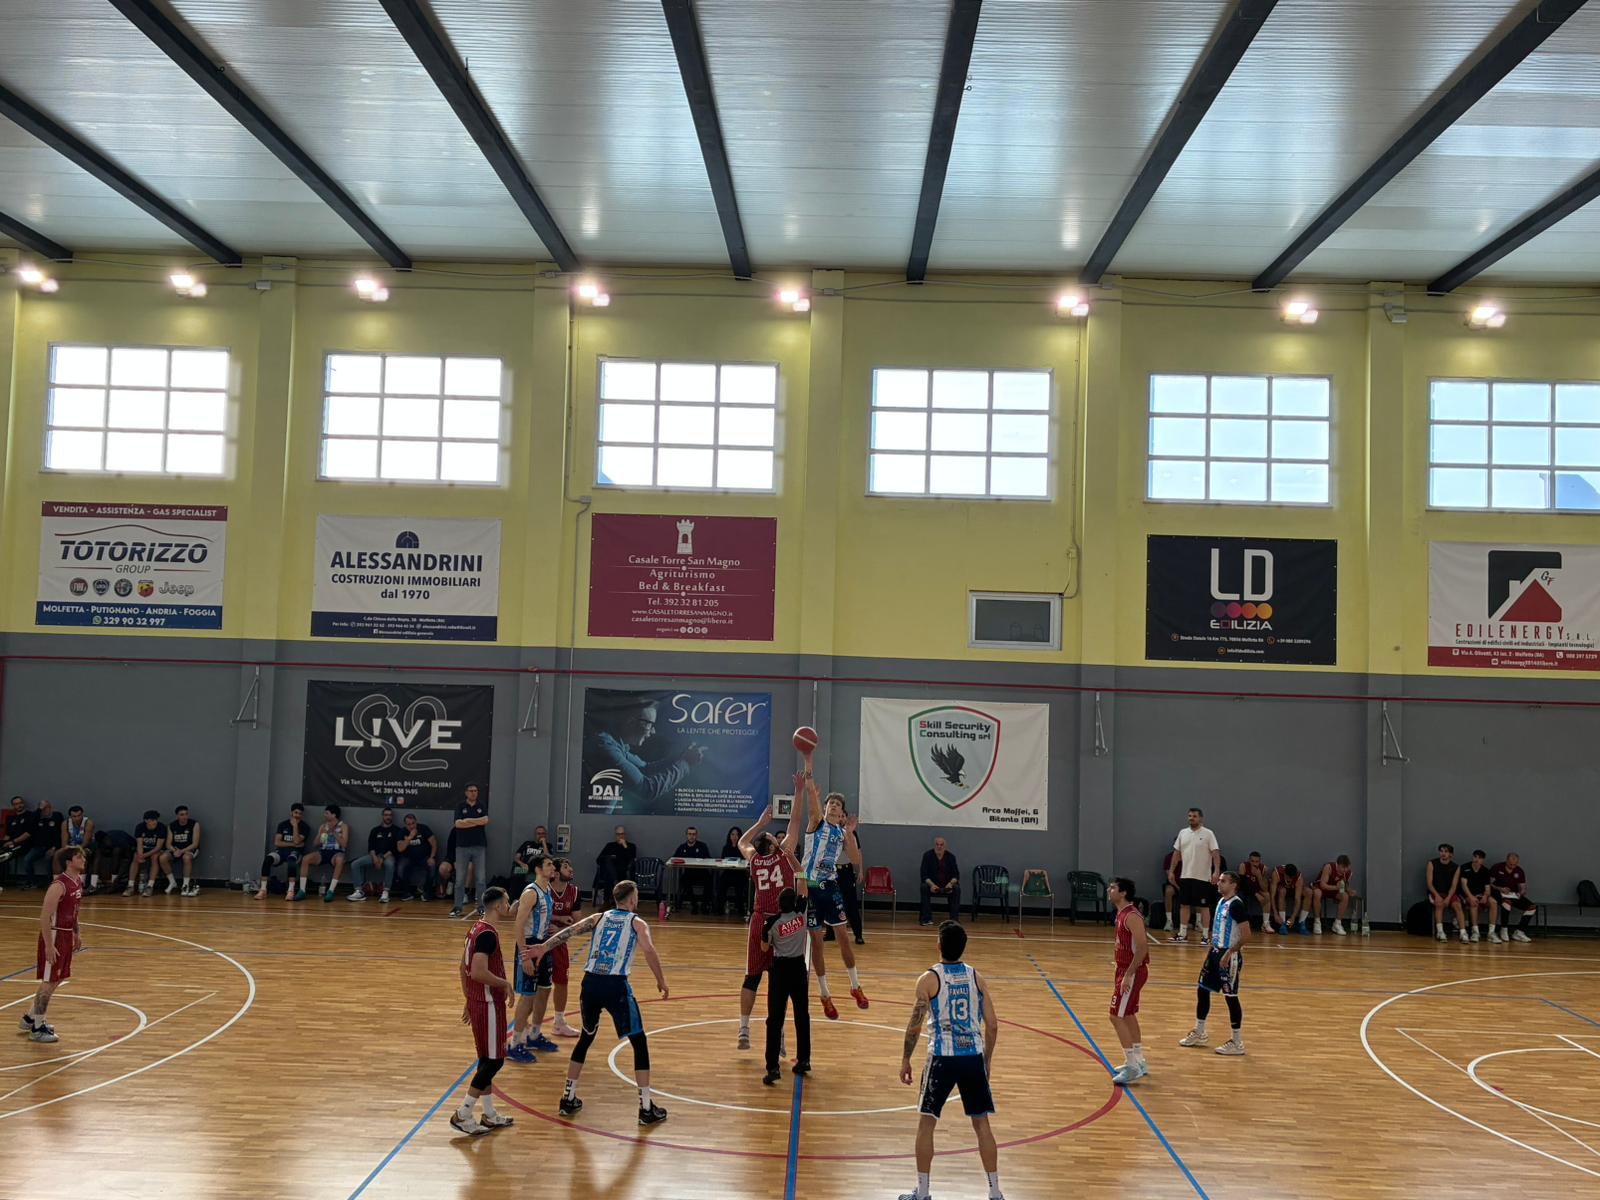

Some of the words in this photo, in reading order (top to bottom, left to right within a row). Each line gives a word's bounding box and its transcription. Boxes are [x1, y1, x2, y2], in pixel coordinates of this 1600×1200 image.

[53, 505, 88, 514] VENDITA
[96, 506, 145, 515] ASSISTENZA
[172, 508, 217, 517] SPECIALIST
[60, 540, 208, 563] TOTORIZZO
[330, 551, 483, 572] ALESSANDRINI
[628, 555, 659, 565] Casale
[661, 555, 686, 565] Torre
[687, 556, 704, 566] San
[706, 557, 740, 569] Magno
[115, 564, 151, 574] GROUP
[649, 569, 716, 581] Agriturismo
[1210, 548, 1274, 601] LD
[332, 574, 404, 585] COSTRUZIONI
[408, 576, 481, 587] IMMOBILIARI
[159, 581, 195, 597] Jeep
[639, 582, 658, 591] Bed
[662, 582, 670, 591] &
[674, 583, 726, 592] Breakfast
[381, 589, 398, 599] dal
[402, 590, 430, 600] 1970
[648, 598, 662, 606] Tel.
[43, 605, 85, 613] MOLFETTA
[91, 605, 139, 615] PUTIGNANO
[146, 607, 177, 615] ANDRIA
[184, 608, 216, 617] FOGGIA
[103, 617, 120, 625] 329
[149, 618, 166, 626] 997
[1456, 623, 1564, 640] EDILENERGY
[668, 694, 766, 725] Safer
[944, 721, 991, 732] Security
[919, 730, 976, 741] Consulting
[592, 785, 619, 796] DAI
[1021, 816, 1039, 824] (BA)
[756, 865, 784, 890] 24
[808, 918, 817, 927] 24
[606, 930, 616, 946] 7
[951, 998, 968, 1021] 13
